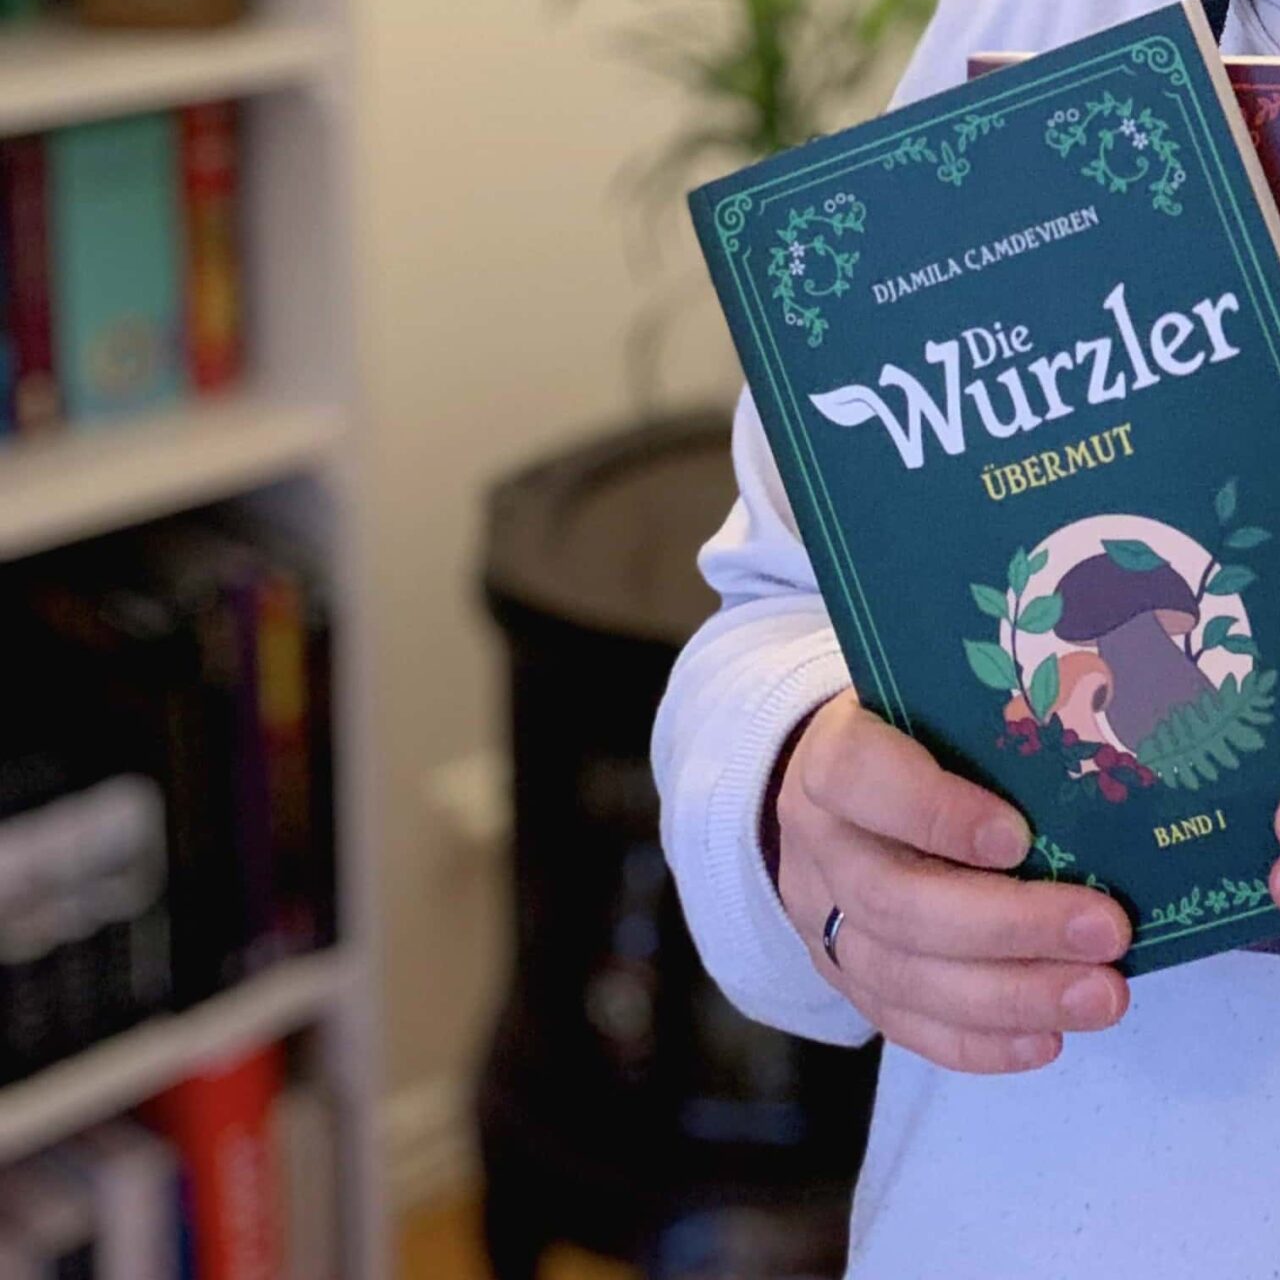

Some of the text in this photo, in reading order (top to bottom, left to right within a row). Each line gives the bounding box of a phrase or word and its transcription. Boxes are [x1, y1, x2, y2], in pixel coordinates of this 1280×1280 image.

[871, 258, 963, 305] DJAMILA
[961, 322, 1033, 370] Die
[807, 282, 1240, 469] Wurzler
[980, 423, 1135, 501] ÜBERMUT
[1153, 814, 1213, 848] BAND
